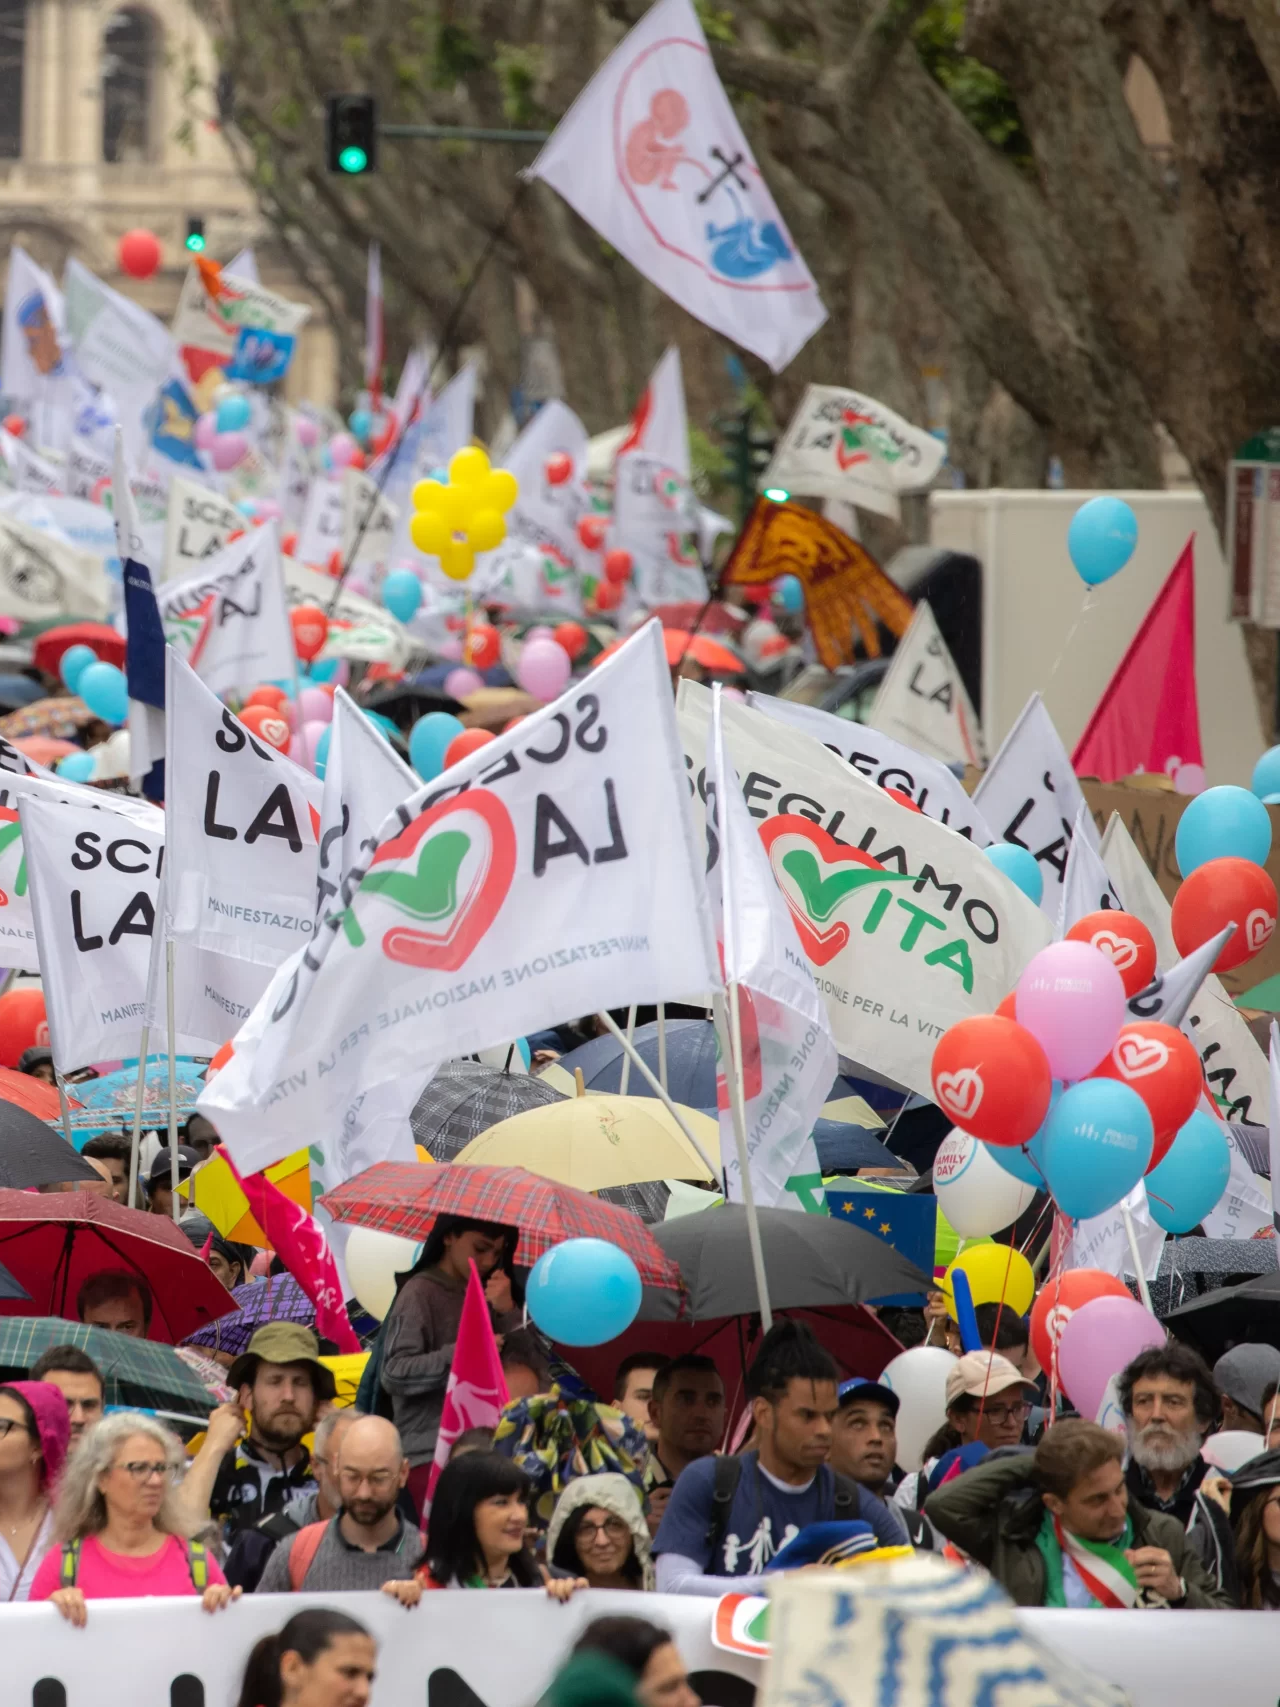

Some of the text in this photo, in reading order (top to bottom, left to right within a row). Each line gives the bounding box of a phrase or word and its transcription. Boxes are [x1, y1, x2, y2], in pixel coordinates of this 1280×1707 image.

[178, 527, 223, 559] LA
[910, 662, 952, 713] LA
[204, 770, 303, 853] LA
[71, 890, 156, 952] LA
[208, 896, 314, 933] MANIFESTAZIO
[853, 995, 884, 1018] PER
[889, 1009, 909, 1028] LA
[918, 1020, 947, 1041] VIT
[935, 1154, 966, 1166] AMILY
[937, 1165, 956, 1177] DAY
